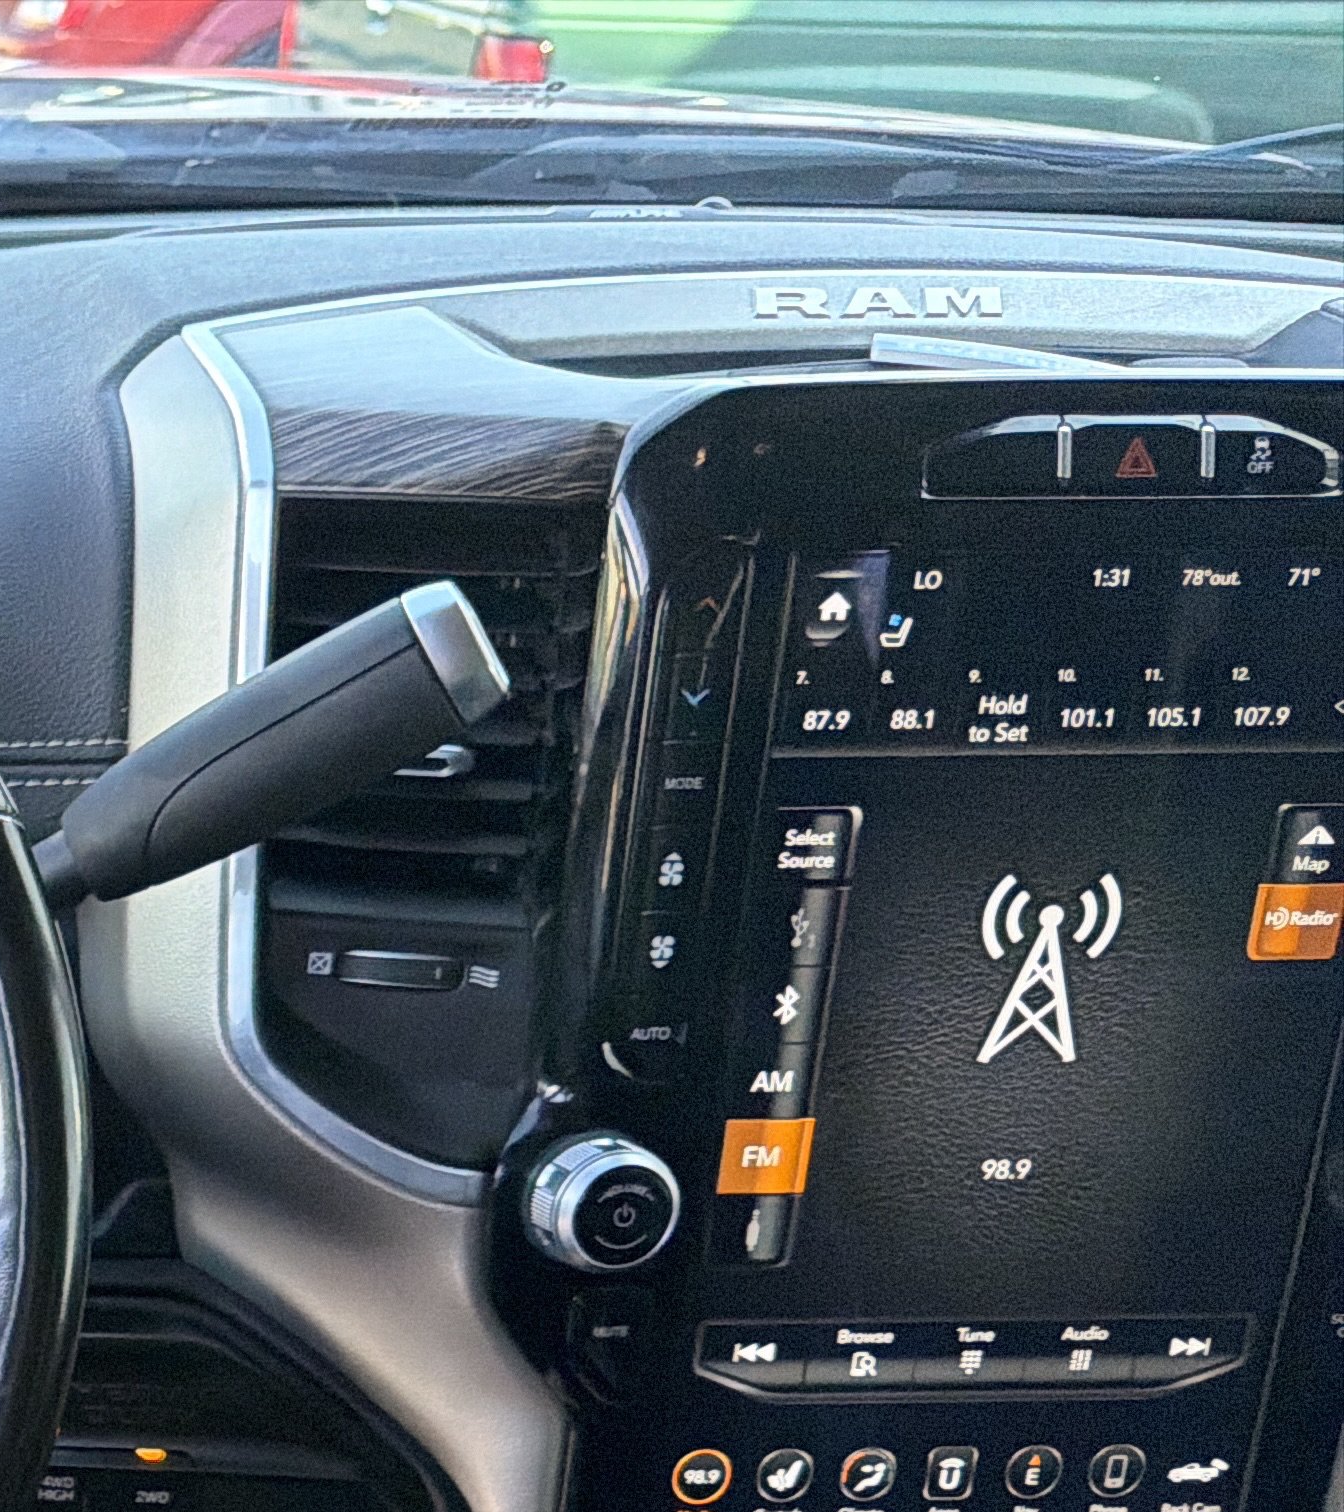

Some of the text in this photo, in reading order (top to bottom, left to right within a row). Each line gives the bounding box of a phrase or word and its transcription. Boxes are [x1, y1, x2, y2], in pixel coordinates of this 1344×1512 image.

[753, 287, 1003, 319] RAM
[1247, 461, 1274, 474] OFF
[913, 570, 943, 590] LO
[1093, 568, 1131, 587] 1:31
[978, 694, 1028, 715] Hold
[802, 710, 851, 730] 87.9
[890, 709, 935, 729] 88.1
[1061, 708, 1115, 728] 101.1
[1147, 707, 1201, 727] 105.1
[1234, 706, 1291, 727] 107.9
[968, 723, 1029, 742] to Set
[664, 777, 704, 790] MODE
[784, 829, 835, 847] Select
[778, 853, 835, 869] Source
[1292, 855, 1330, 875] Map
[630, 1027, 670, 1040] AUTO
[749, 1070, 795, 1093] AM
[741, 1146, 781, 1168] FM
[981, 1159, 1033, 1181] 98.9
[836, 1330, 894, 1345] Browse
[957, 1328, 994, 1344] Tune
[1061, 1327, 1109, 1343] Audio
[684, 1469, 720, 1484] 98.9
[1025, 1468, 1040, 1486] E
[135, 1490, 169, 1504] 2WD
